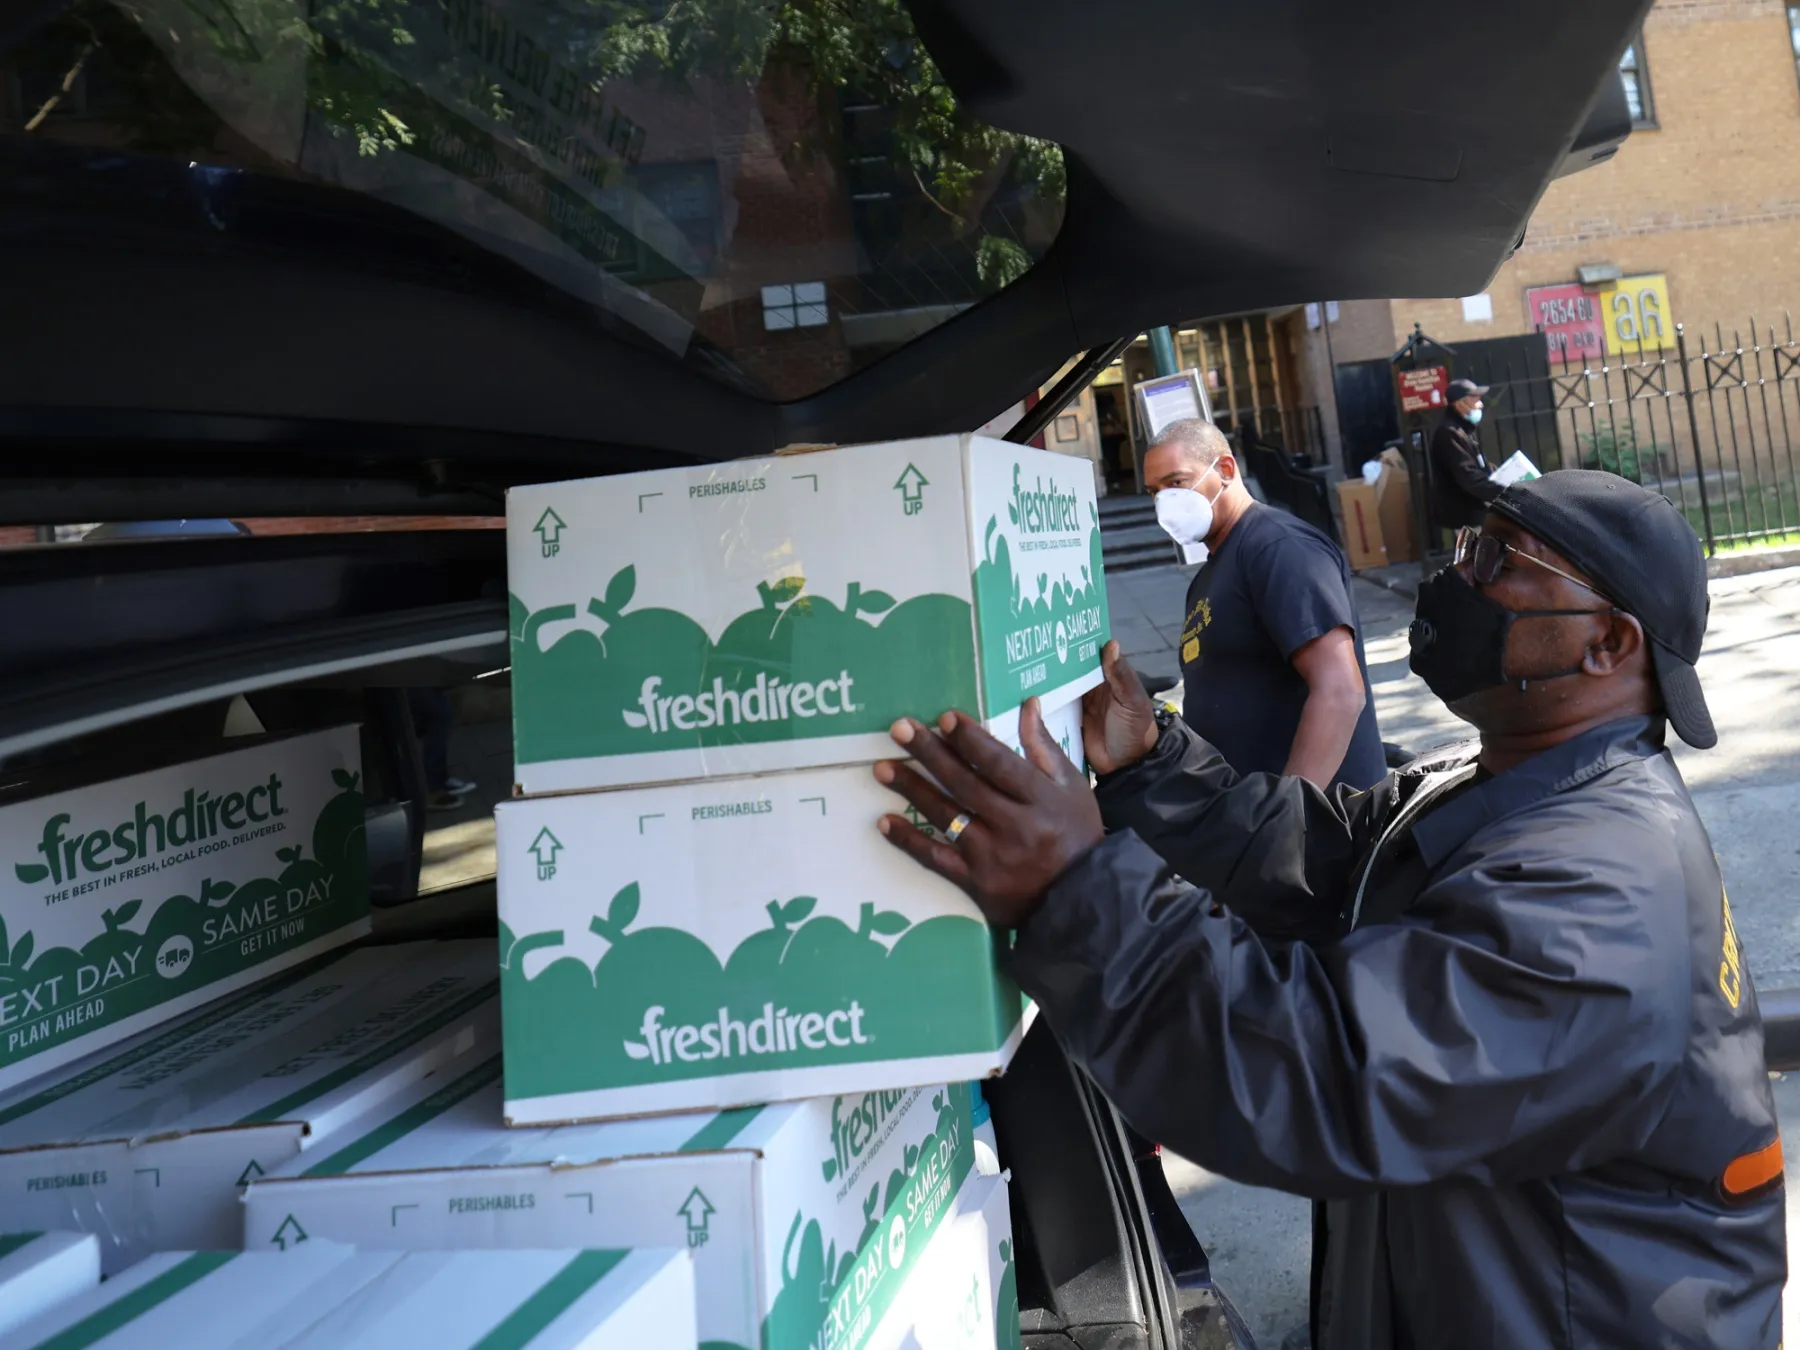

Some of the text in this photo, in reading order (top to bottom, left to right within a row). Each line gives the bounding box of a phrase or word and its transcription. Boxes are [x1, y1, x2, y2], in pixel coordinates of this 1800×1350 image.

[689, 478, 766, 499] PERISHABLES
[904, 501, 923, 516] UP
[1013, 462, 1080, 534] freshdirect
[541, 543, 561, 558] UP
[1005, 621, 1052, 664] NEXT DAY
[1066, 605, 1101, 640] SAME DAY
[636, 670, 856, 733] freshdirect
[36, 773, 284, 886] freshdirect
[691, 800, 773, 821] PERISHABLES
[44, 822, 287, 907] THE BEST IN FRESH, LOCAL FOOD. DELIVERED.
[536, 865, 557, 882] UP
[202, 873, 335, 946] SAME DAY
[240, 918, 305, 957] GET IT NOW
[0, 945, 143, 1027] EXT DAY
[8, 998, 105, 1053] PLAN AHEAD
[636, 1001, 868, 1065] freshdirect
[27, 1171, 107, 1192] PERISHABLES
[906, 1117, 959, 1223] SAME DAY
[449, 1194, 535, 1214] PERISHABLES
[924, 1199, 935, 1228] GET
[687, 1231, 709, 1248] UP
[855, 1233, 883, 1305] DAY
